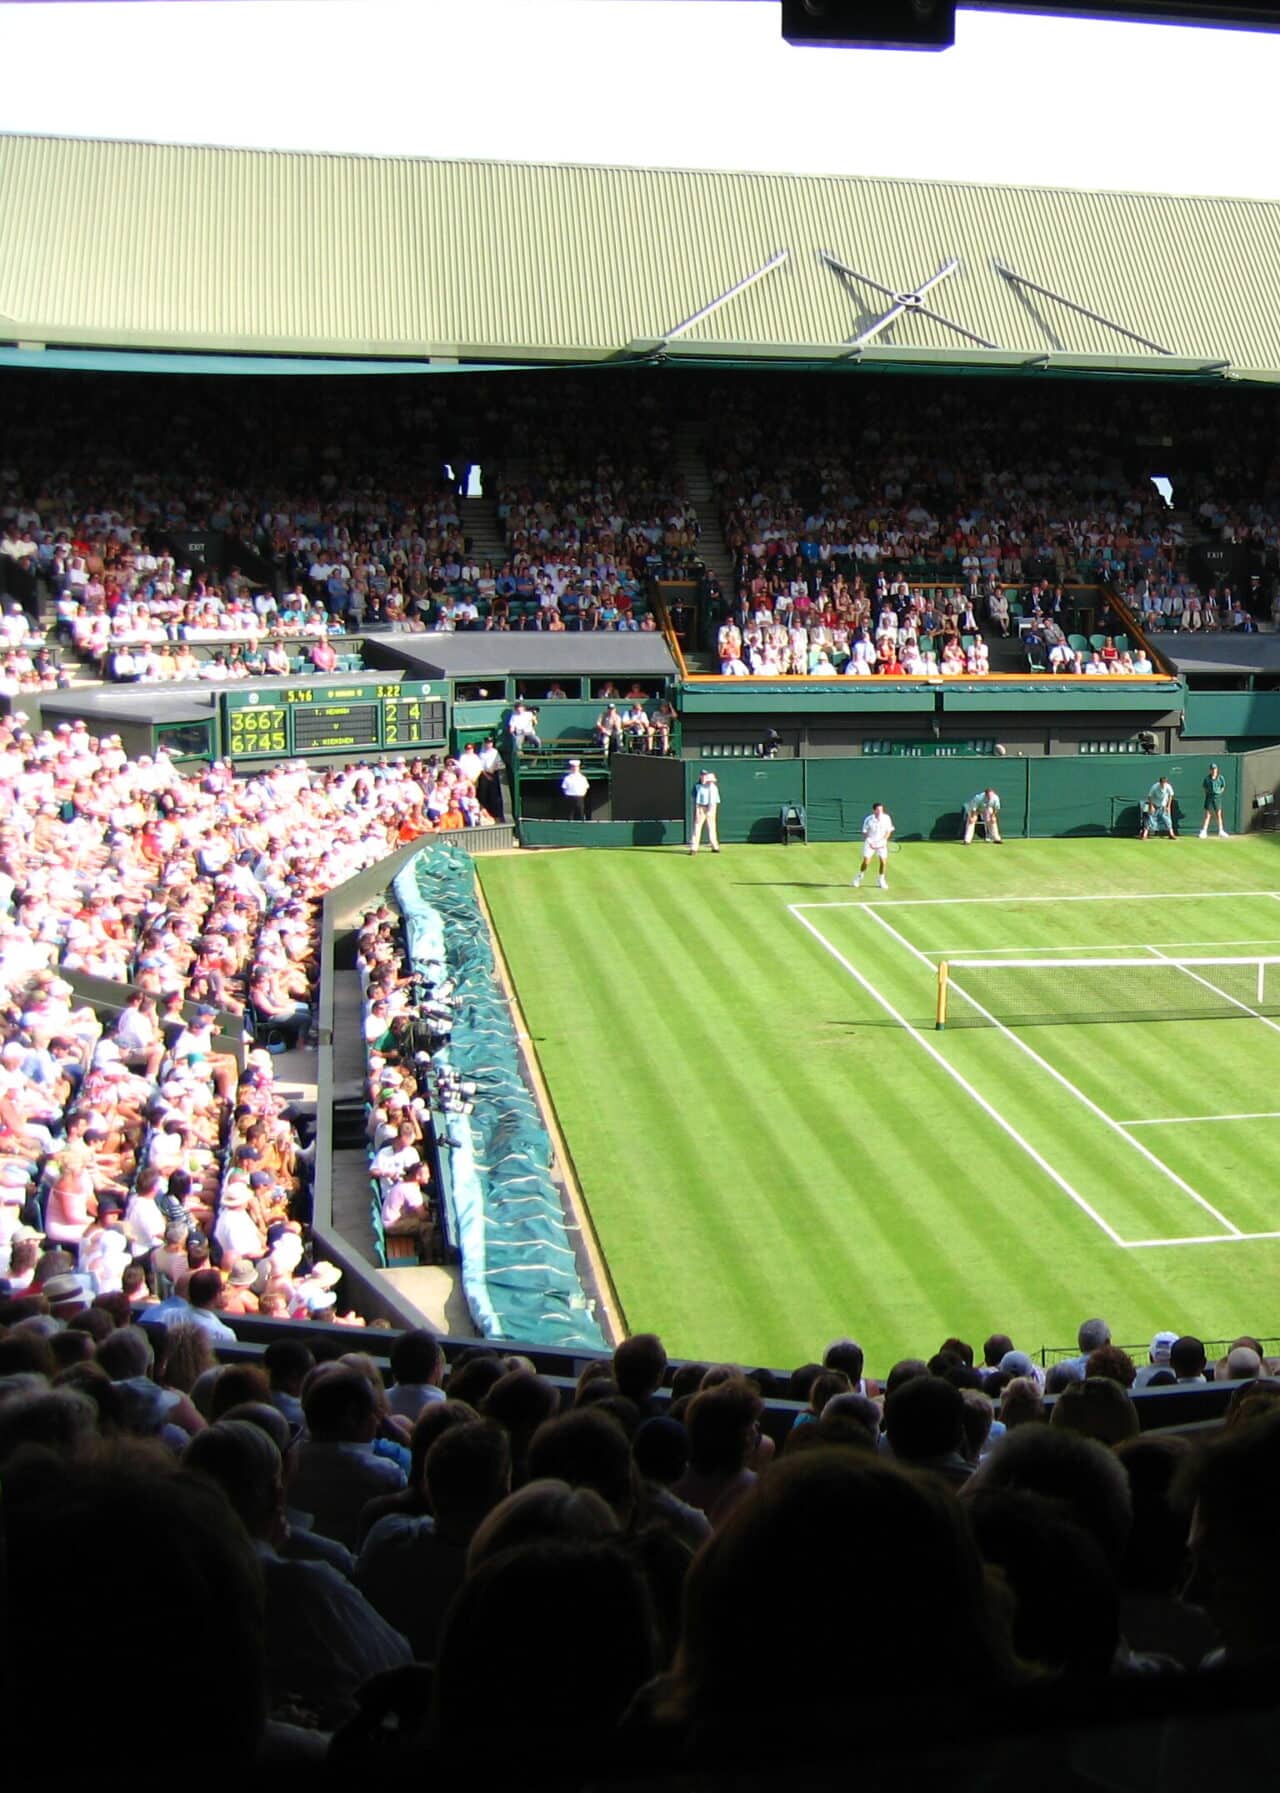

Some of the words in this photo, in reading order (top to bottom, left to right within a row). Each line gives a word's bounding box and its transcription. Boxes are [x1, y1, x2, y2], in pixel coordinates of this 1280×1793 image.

[1207, 551, 1224, 559] EXIT
[385, 705, 397, 722] 2
[409, 703, 420, 720] 4
[386, 724, 397, 742] 2
[411, 723, 419, 740] 1
